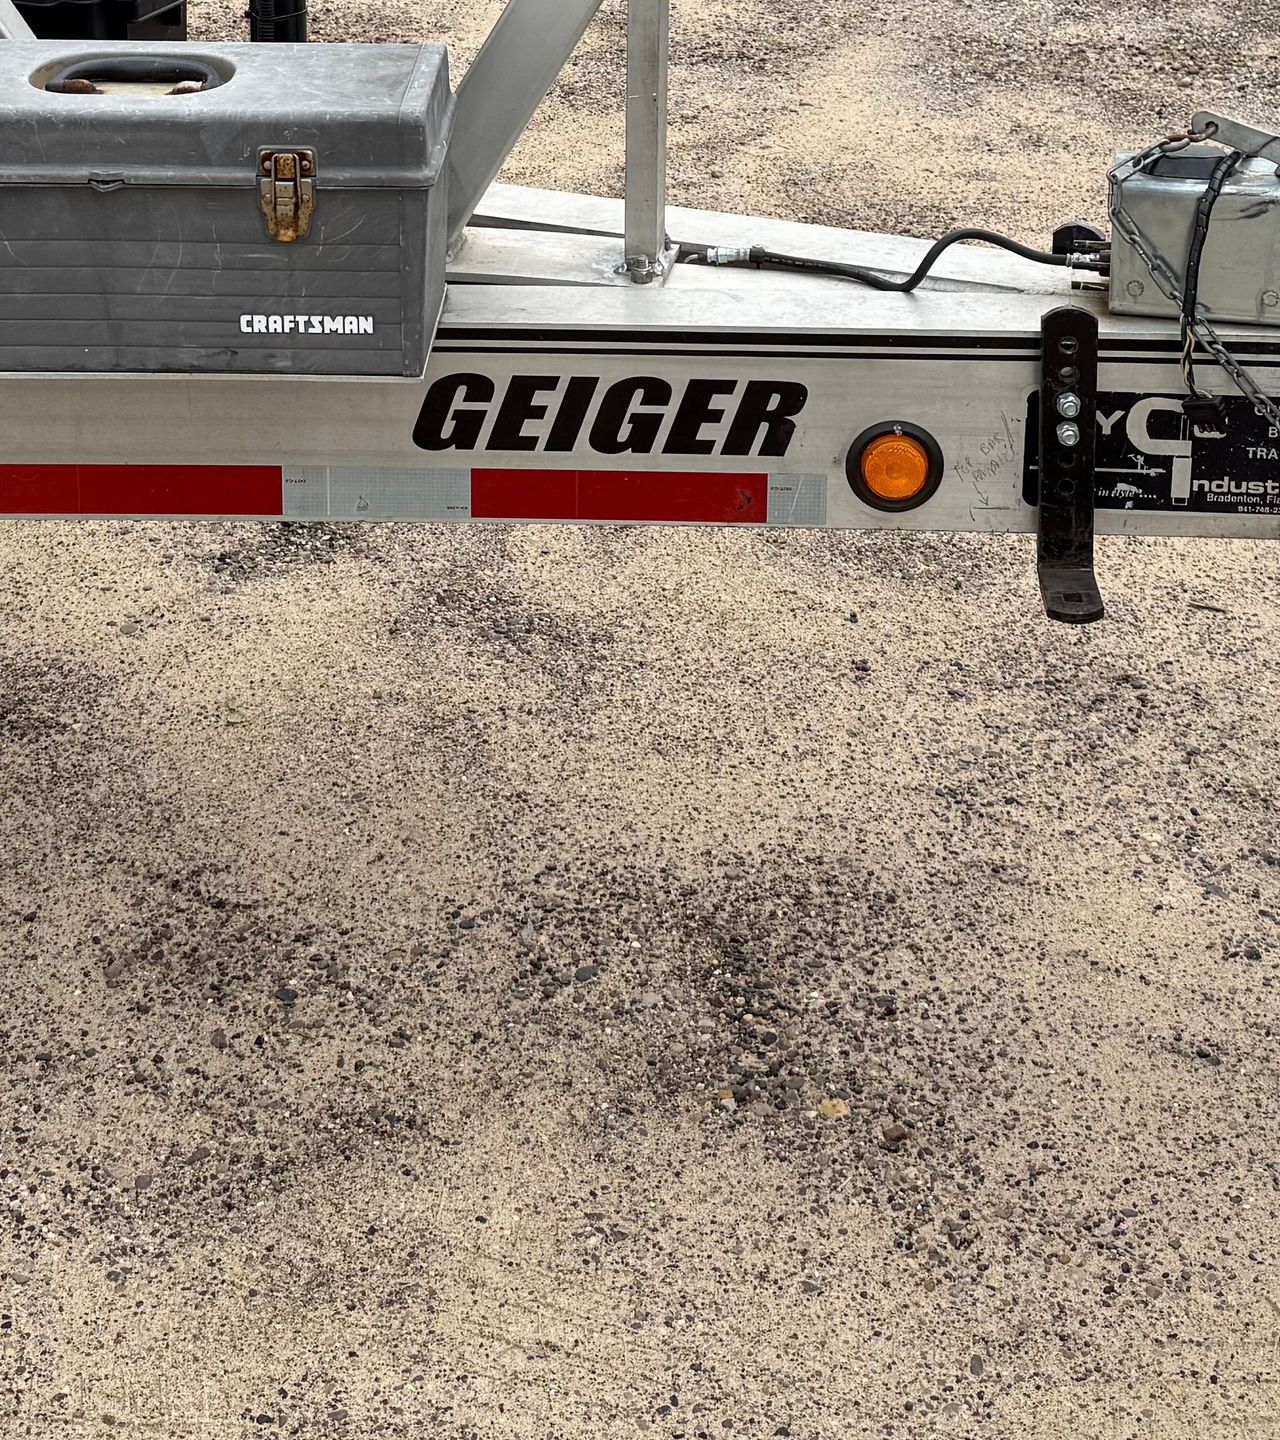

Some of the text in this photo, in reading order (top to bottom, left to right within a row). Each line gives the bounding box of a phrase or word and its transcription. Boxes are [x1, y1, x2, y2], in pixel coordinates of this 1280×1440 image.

[239, 314, 374, 334] CRAFTSMAN
[412, 372, 808, 457] GEIGER
[1206, 493, 1264, 505] Bradenton,
